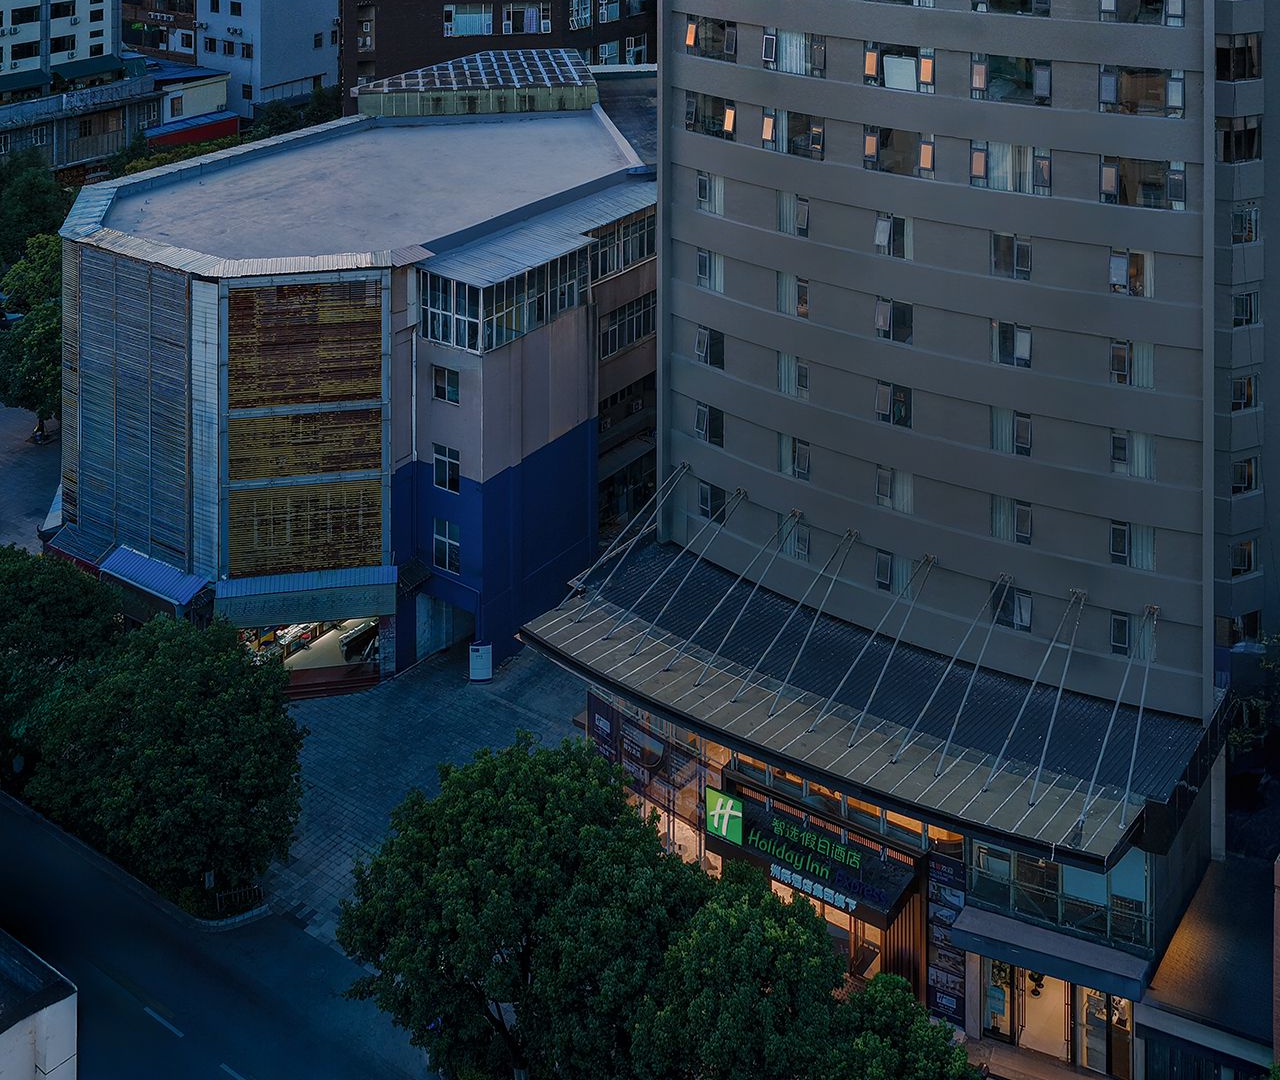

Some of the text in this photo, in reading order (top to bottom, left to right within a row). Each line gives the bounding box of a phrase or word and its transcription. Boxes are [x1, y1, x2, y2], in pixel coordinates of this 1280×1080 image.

[747, 828, 888, 903] Holiday Inn Express
[771, 816, 862, 870] 智选假日酒店
[770, 863, 858, 913] 洲际酒店集团旗下
